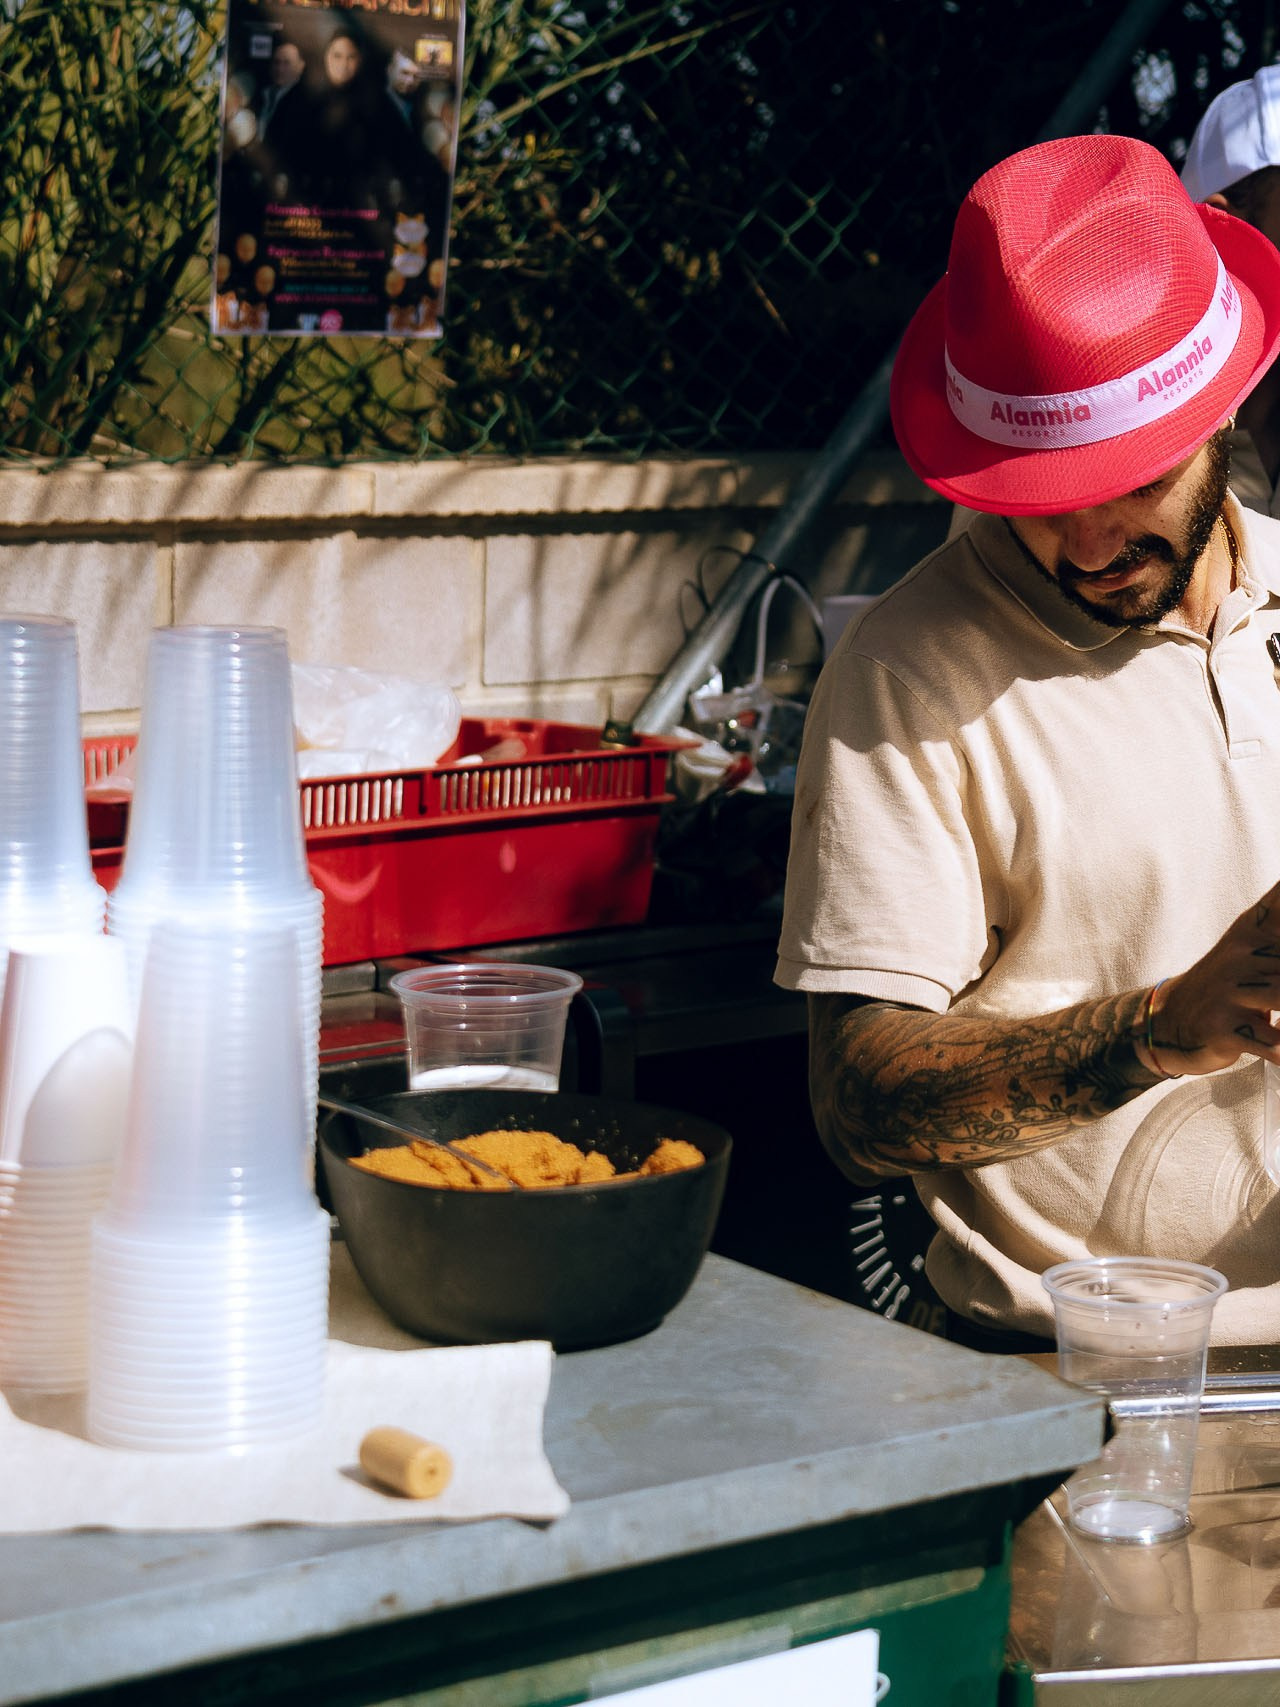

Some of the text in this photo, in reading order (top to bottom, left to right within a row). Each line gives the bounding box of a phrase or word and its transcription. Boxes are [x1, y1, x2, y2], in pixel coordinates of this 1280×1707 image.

[1138, 336, 1213, 402] Alannia
[1163, 368, 1204, 400] RESORTS
[990, 401, 1091, 426] Alannia
[1012, 429, 1066, 438] RESORTS
